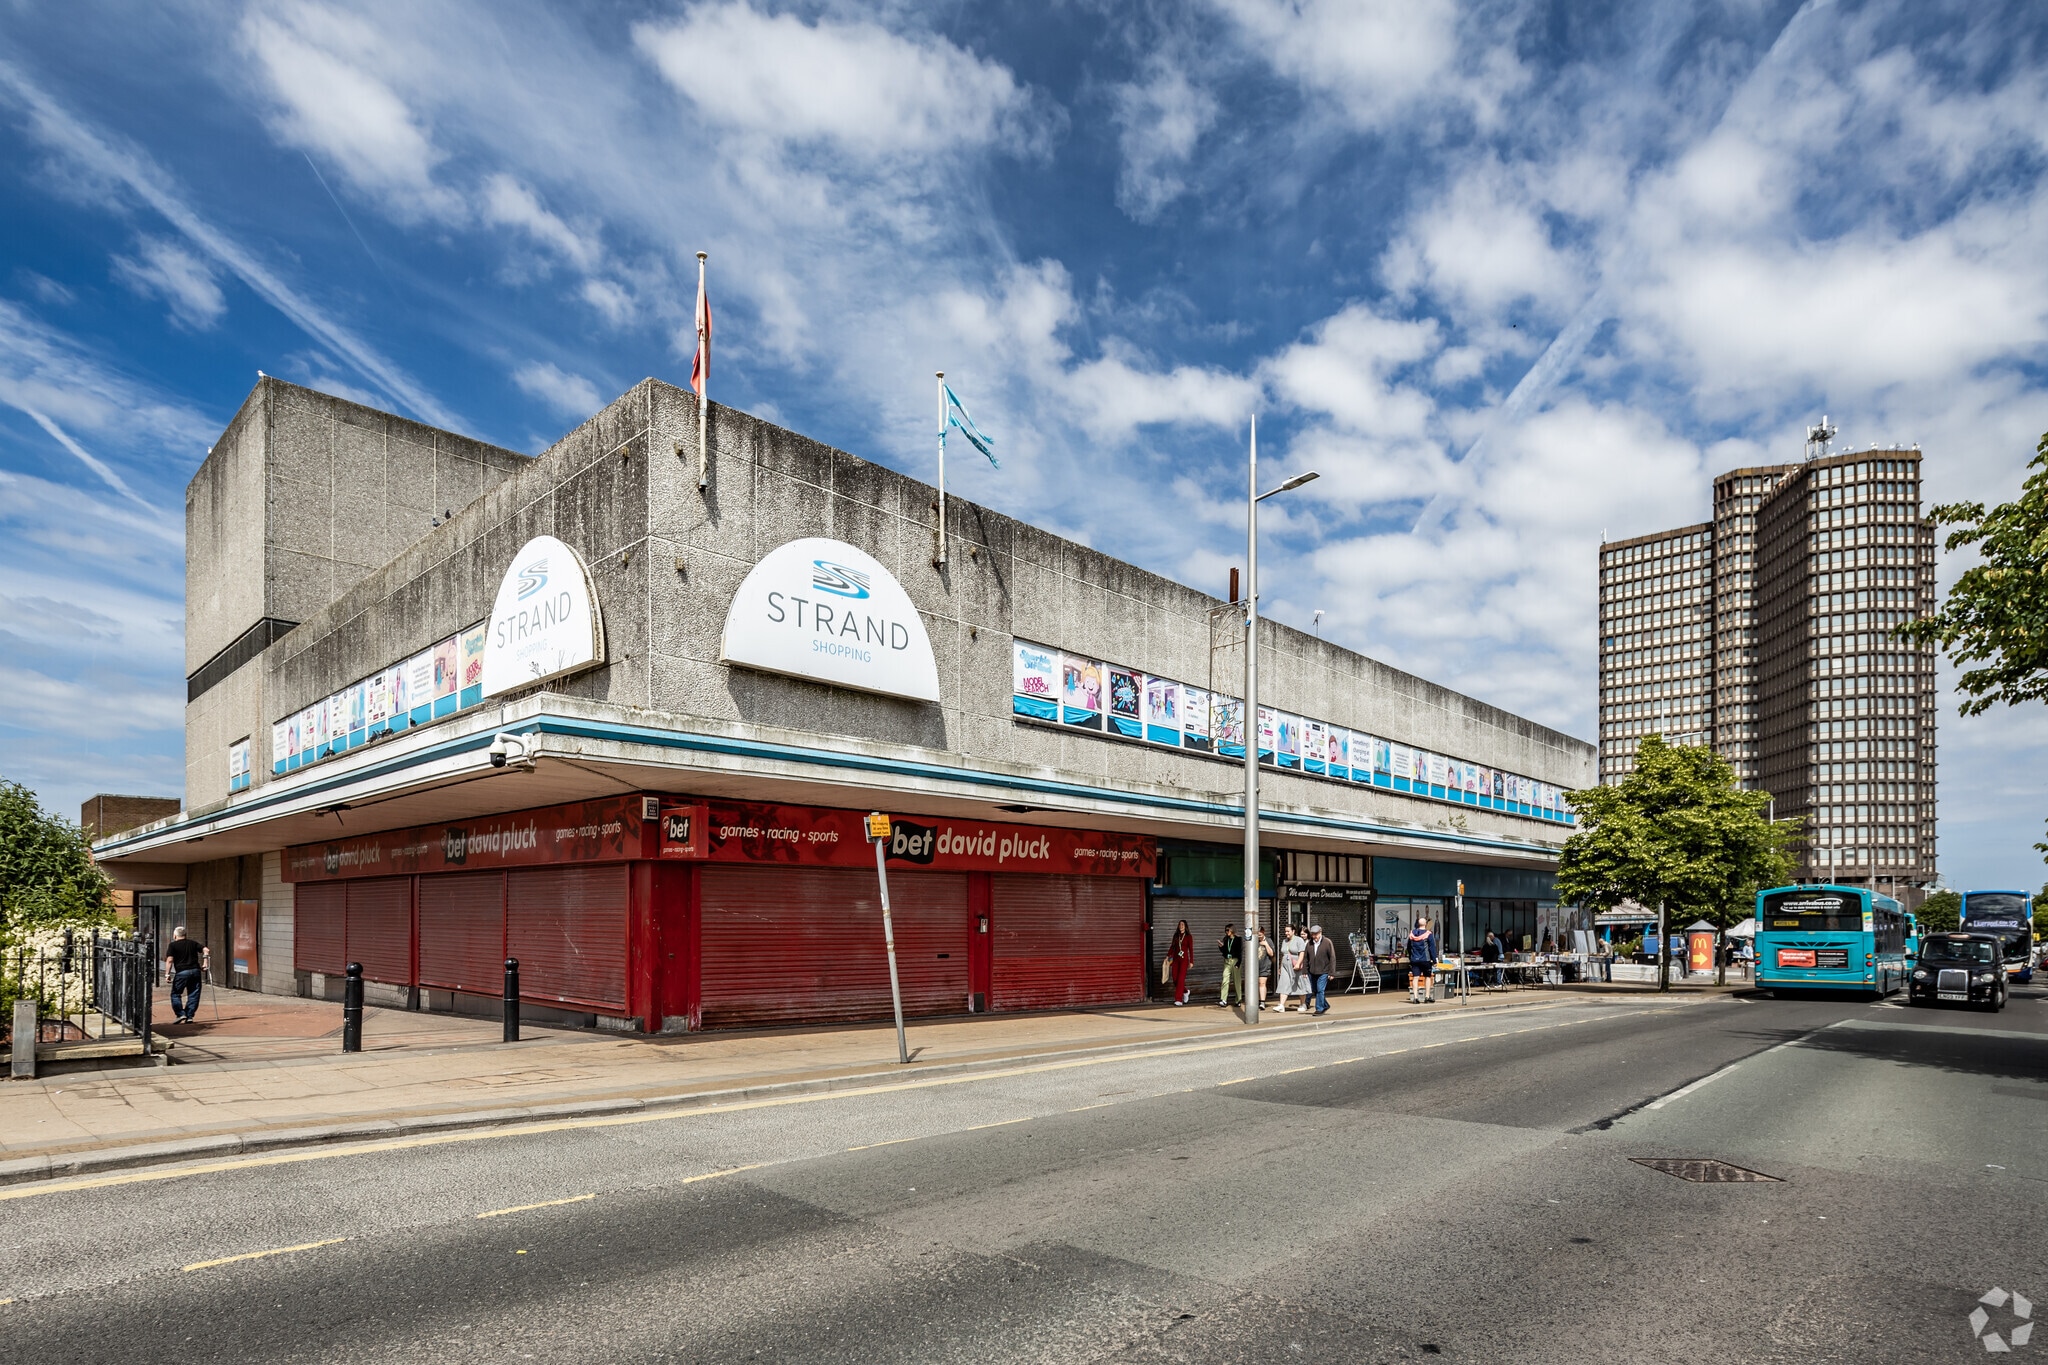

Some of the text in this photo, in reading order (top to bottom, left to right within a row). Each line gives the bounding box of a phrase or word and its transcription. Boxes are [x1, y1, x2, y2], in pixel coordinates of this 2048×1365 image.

[497, 591, 572, 649] STRAND
[767, 591, 909, 650] STRAND
[516, 638, 548, 661] SHOPPING
[812, 639, 872, 663] SHOPPING
[1023, 677, 1042, 686] MODEL
[1024, 682, 1049, 692] SEARCH
[447, 832, 466, 858] bet
[468, 824, 500, 854] david
[502, 819, 537, 858] pluck
[556, 820, 621, 842] games racing sports
[670, 818, 689, 838] bet
[720, 825, 839, 845] games racing sports
[360, 841, 380, 870] pluck
[892, 826, 1050, 864] bet david pluck
[1074, 847, 1139, 862] games racing sports
[1288, 887, 1297, 897] We
[1298, 889, 1309, 897] need
[1310, 891, 1320, 899] your
[1376, 928, 1408, 941] STRAND
